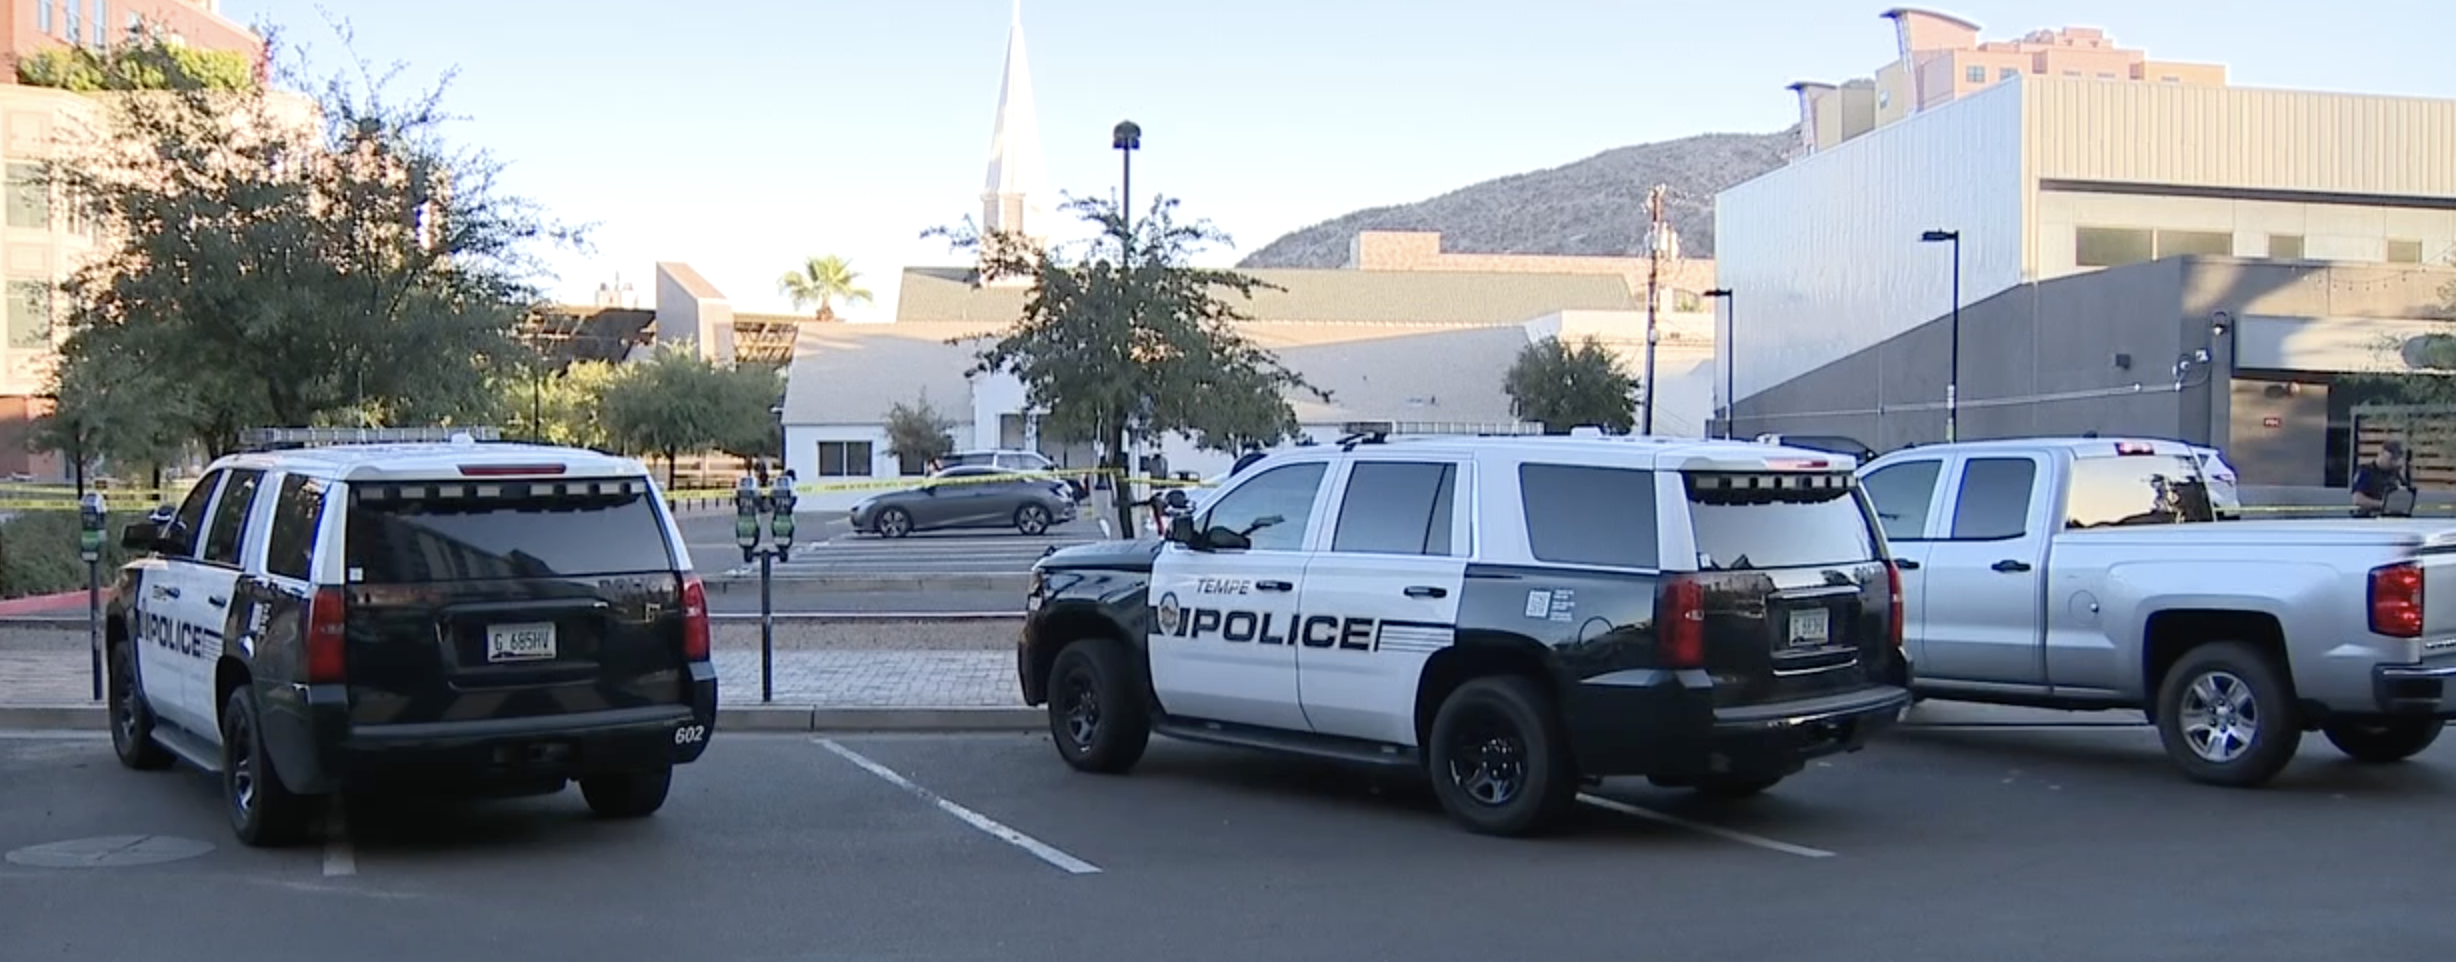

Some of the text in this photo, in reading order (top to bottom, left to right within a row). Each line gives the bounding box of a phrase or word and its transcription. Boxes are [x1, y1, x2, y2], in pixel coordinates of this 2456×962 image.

[1196, 578, 1251, 595] TEMPE
[149, 610, 203, 659] POLICE
[1190, 607, 1374, 651] POLICE
[494, 633, 503, 651] G
[674, 724, 705, 745] 602
